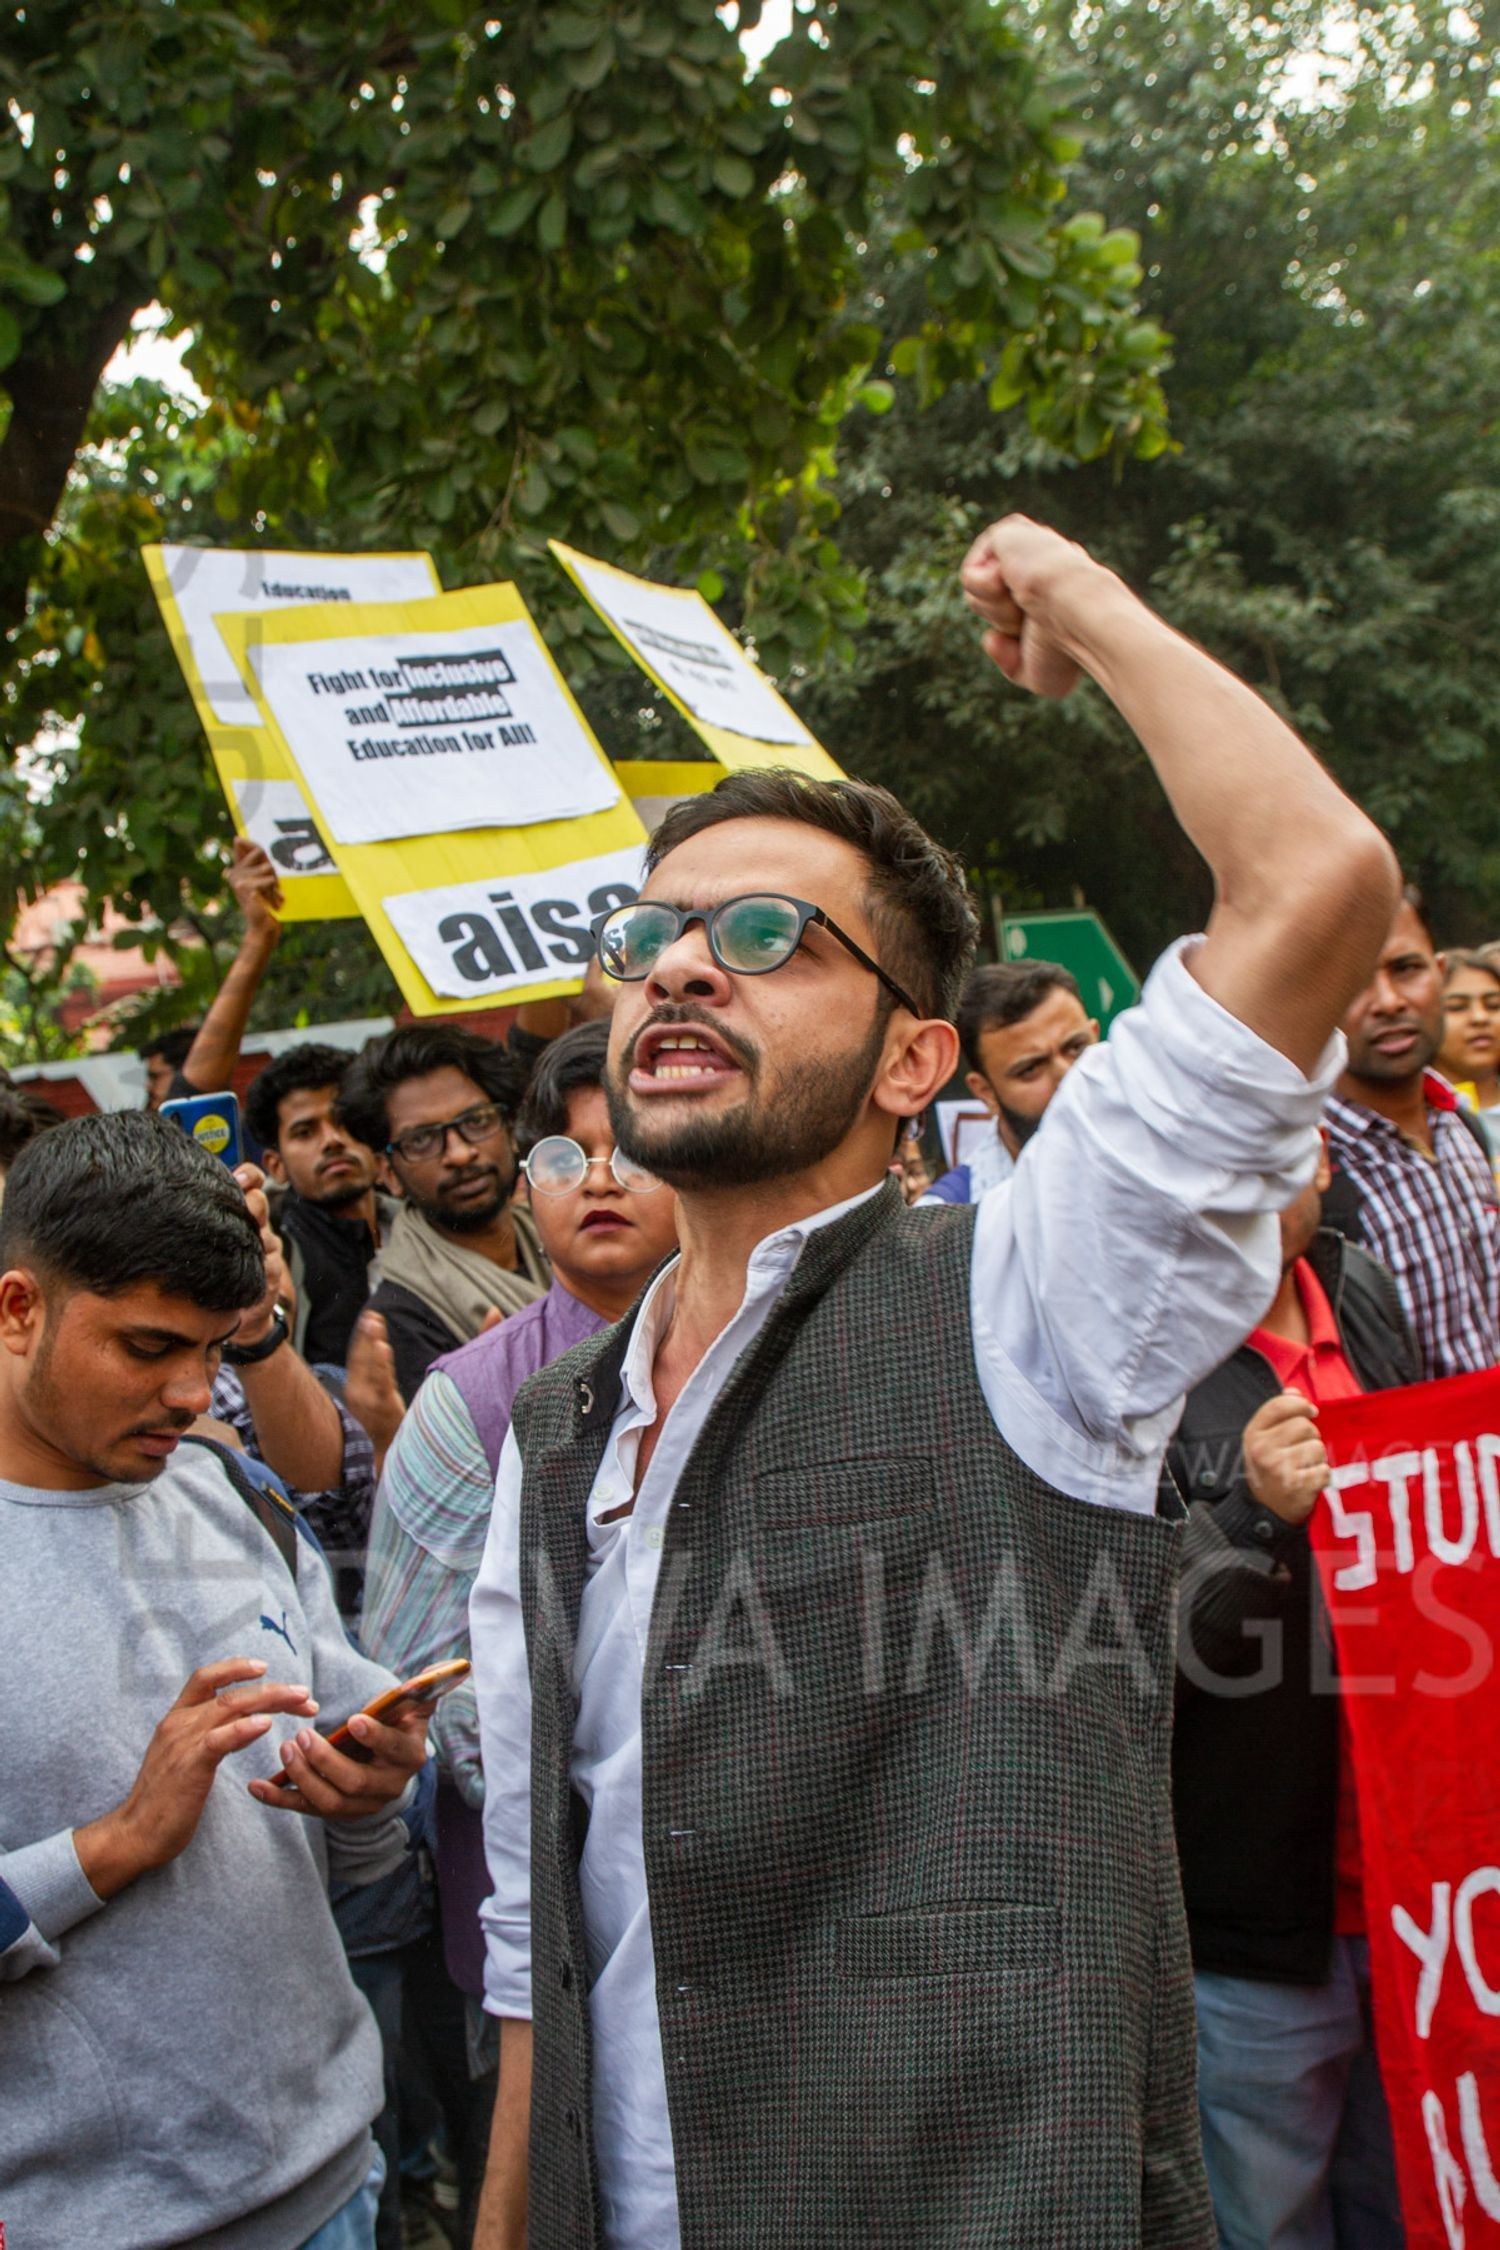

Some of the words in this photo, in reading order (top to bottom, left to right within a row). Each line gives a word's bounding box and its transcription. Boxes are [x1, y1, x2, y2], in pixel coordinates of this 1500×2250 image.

[307, 671, 367, 695] Fight
[369, 667, 402, 688] for
[402, 657, 511, 690] Inclusive
[345, 702, 390, 726] and
[390, 691, 509, 725] Affordable
[346, 732, 463, 762] Education
[462, 729, 495, 752] for
[497, 723, 538, 748] All!
